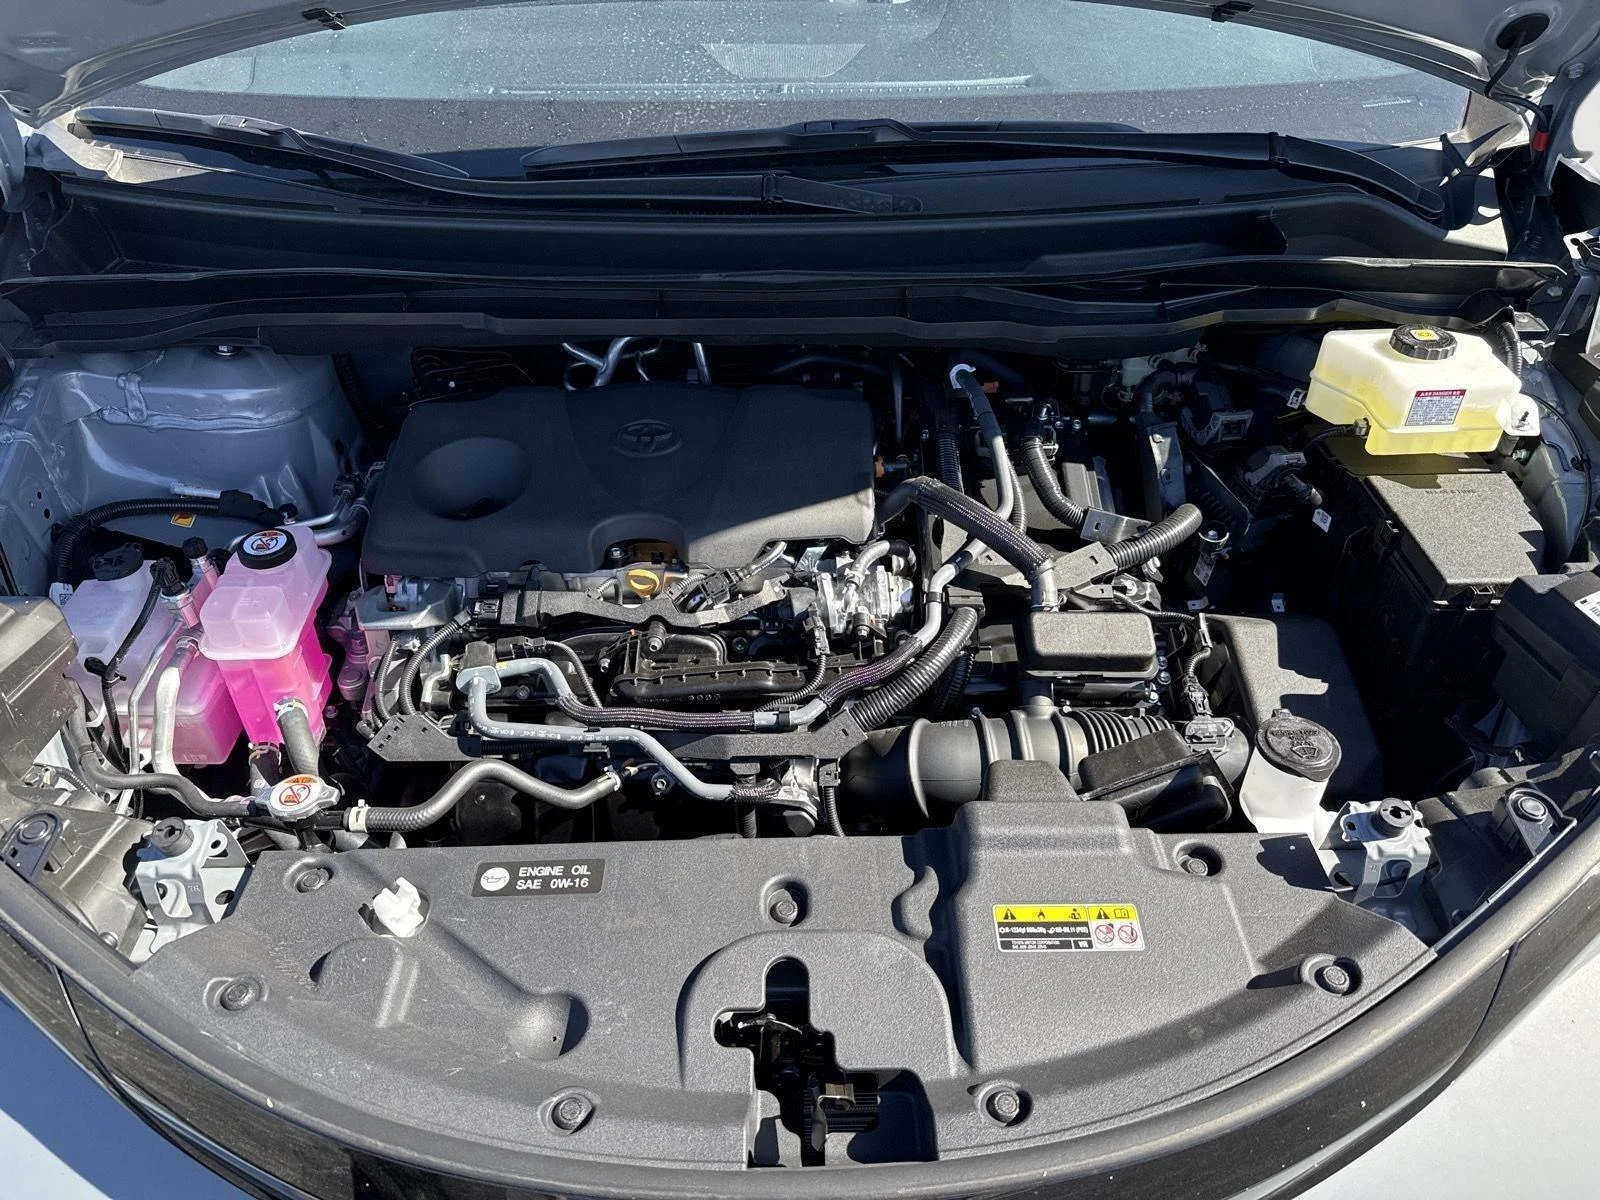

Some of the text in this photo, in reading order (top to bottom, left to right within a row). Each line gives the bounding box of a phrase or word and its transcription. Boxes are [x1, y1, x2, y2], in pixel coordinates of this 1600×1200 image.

[518, 865, 591, 877] ENGINE OIL
[516, 878, 589, 890] SAE 0W-16
